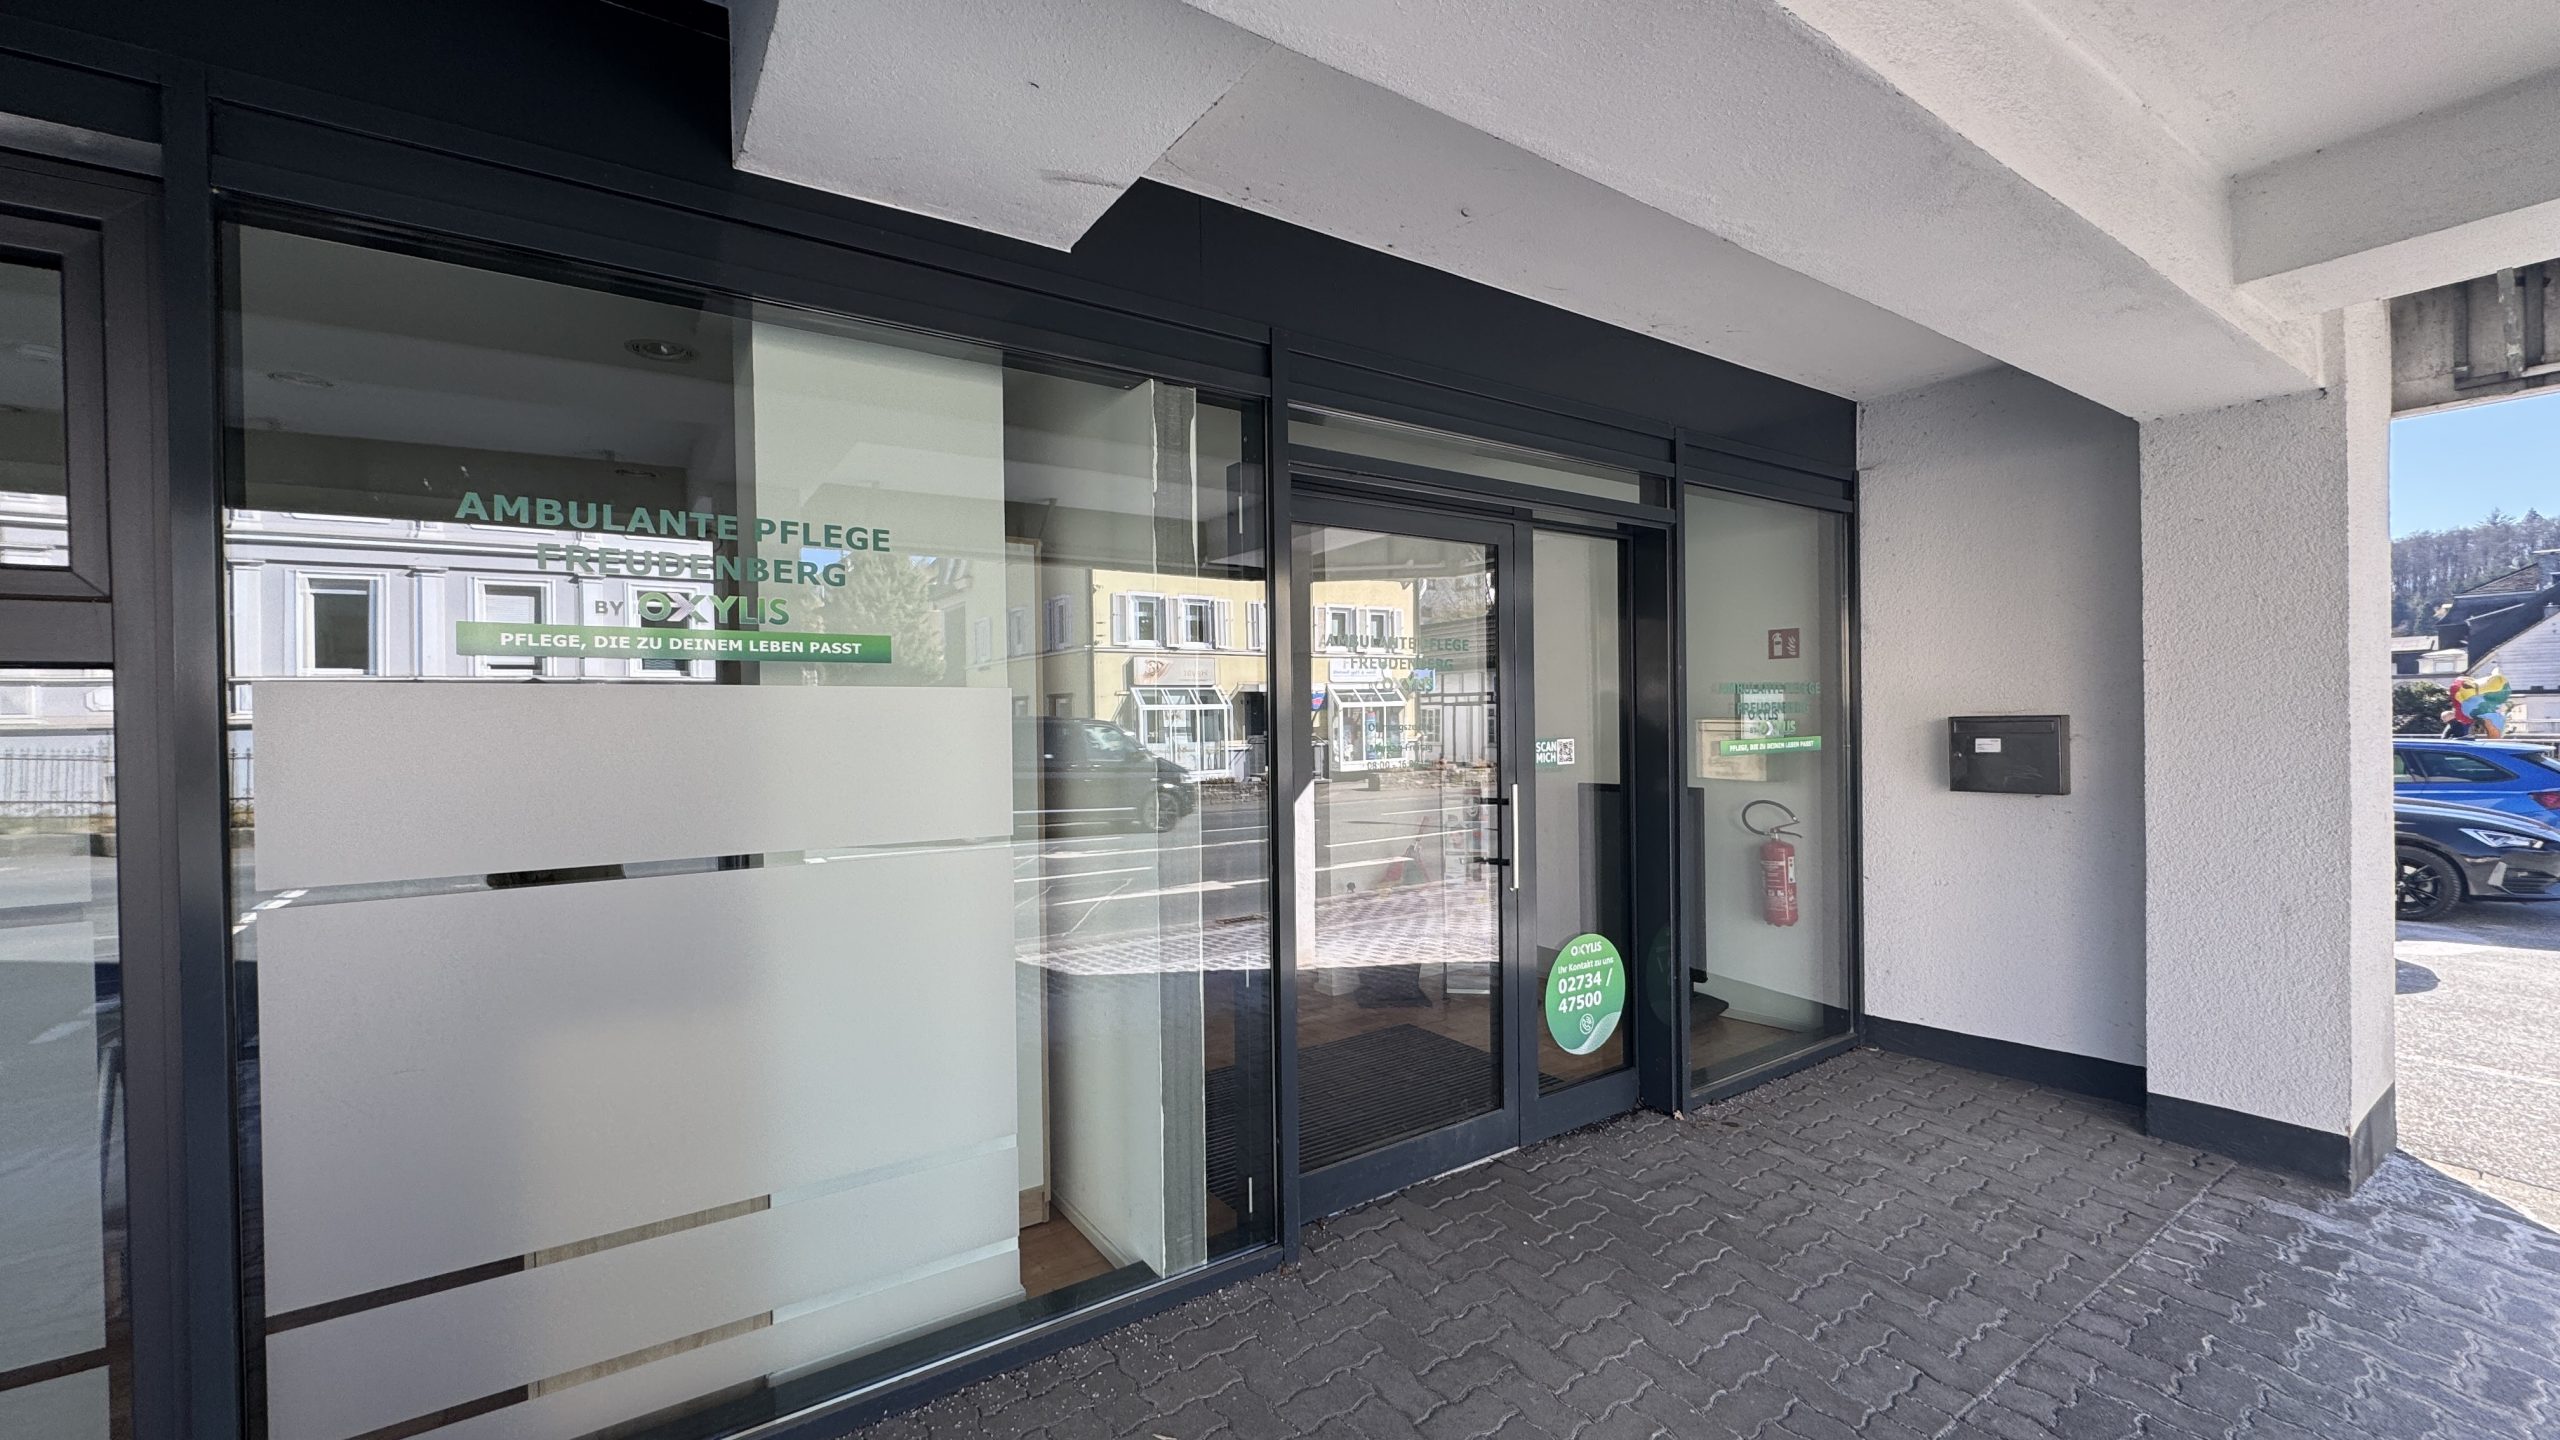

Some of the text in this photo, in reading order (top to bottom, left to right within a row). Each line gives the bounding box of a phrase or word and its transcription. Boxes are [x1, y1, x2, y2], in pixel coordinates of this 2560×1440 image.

[454, 491, 891, 552] AMBULANTE PFLEGE
[537, 542, 846, 587] FREUDENBERG
[595, 591, 790, 626] BY OXYLIS
[500, 632, 862, 655] PFLEGE, DIE ZU DEINEM LEBEN PASST
[1536, 741, 1557, 752] SCAN
[1536, 752, 1556, 763] MICH
[1568, 960, 1594, 971] Kontakt
[1602, 957, 1614, 965] uns
[1558, 967, 1613, 994] 02734 /
[1558, 991, 1602, 1013] 47500
